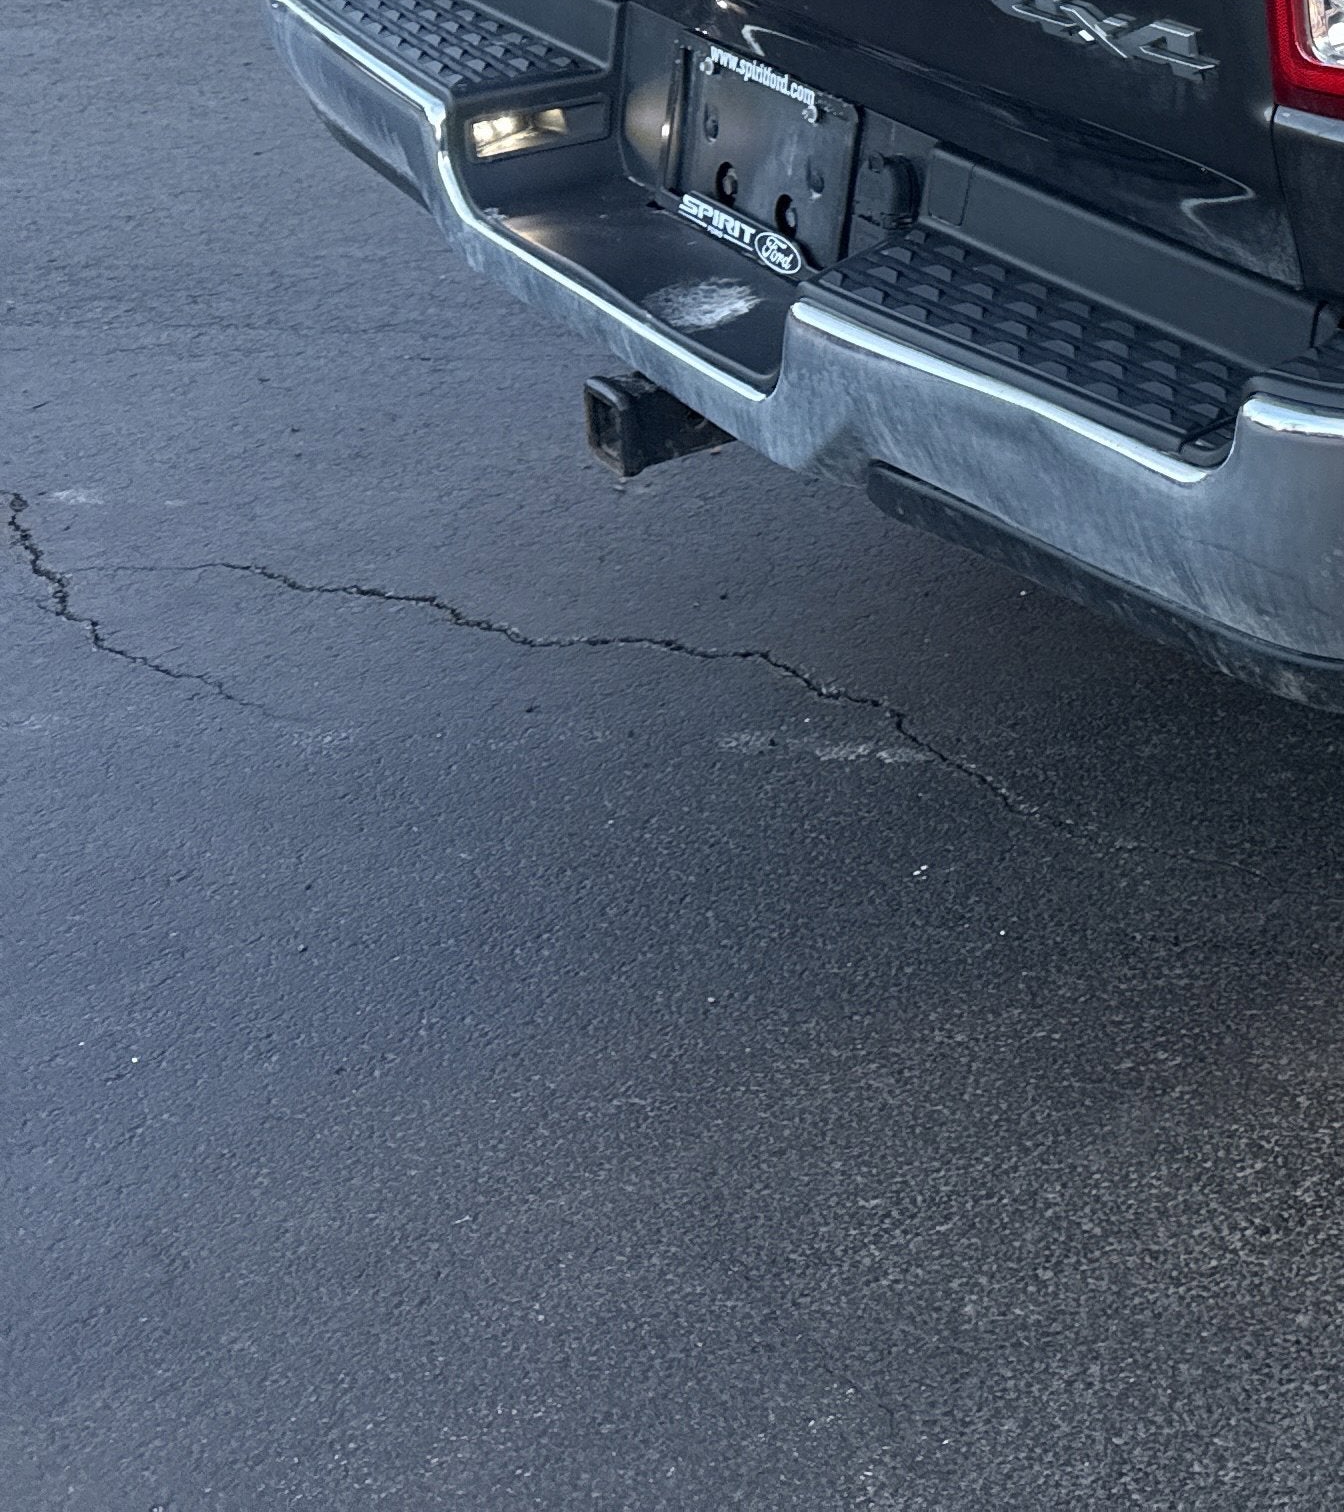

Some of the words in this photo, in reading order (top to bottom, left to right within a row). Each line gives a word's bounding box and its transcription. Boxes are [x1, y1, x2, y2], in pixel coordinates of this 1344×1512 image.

[711, 46, 815, 106] www.spiritford.com
[679, 194, 756, 244] SPIRIT
[761, 236, 793, 270] Ford
